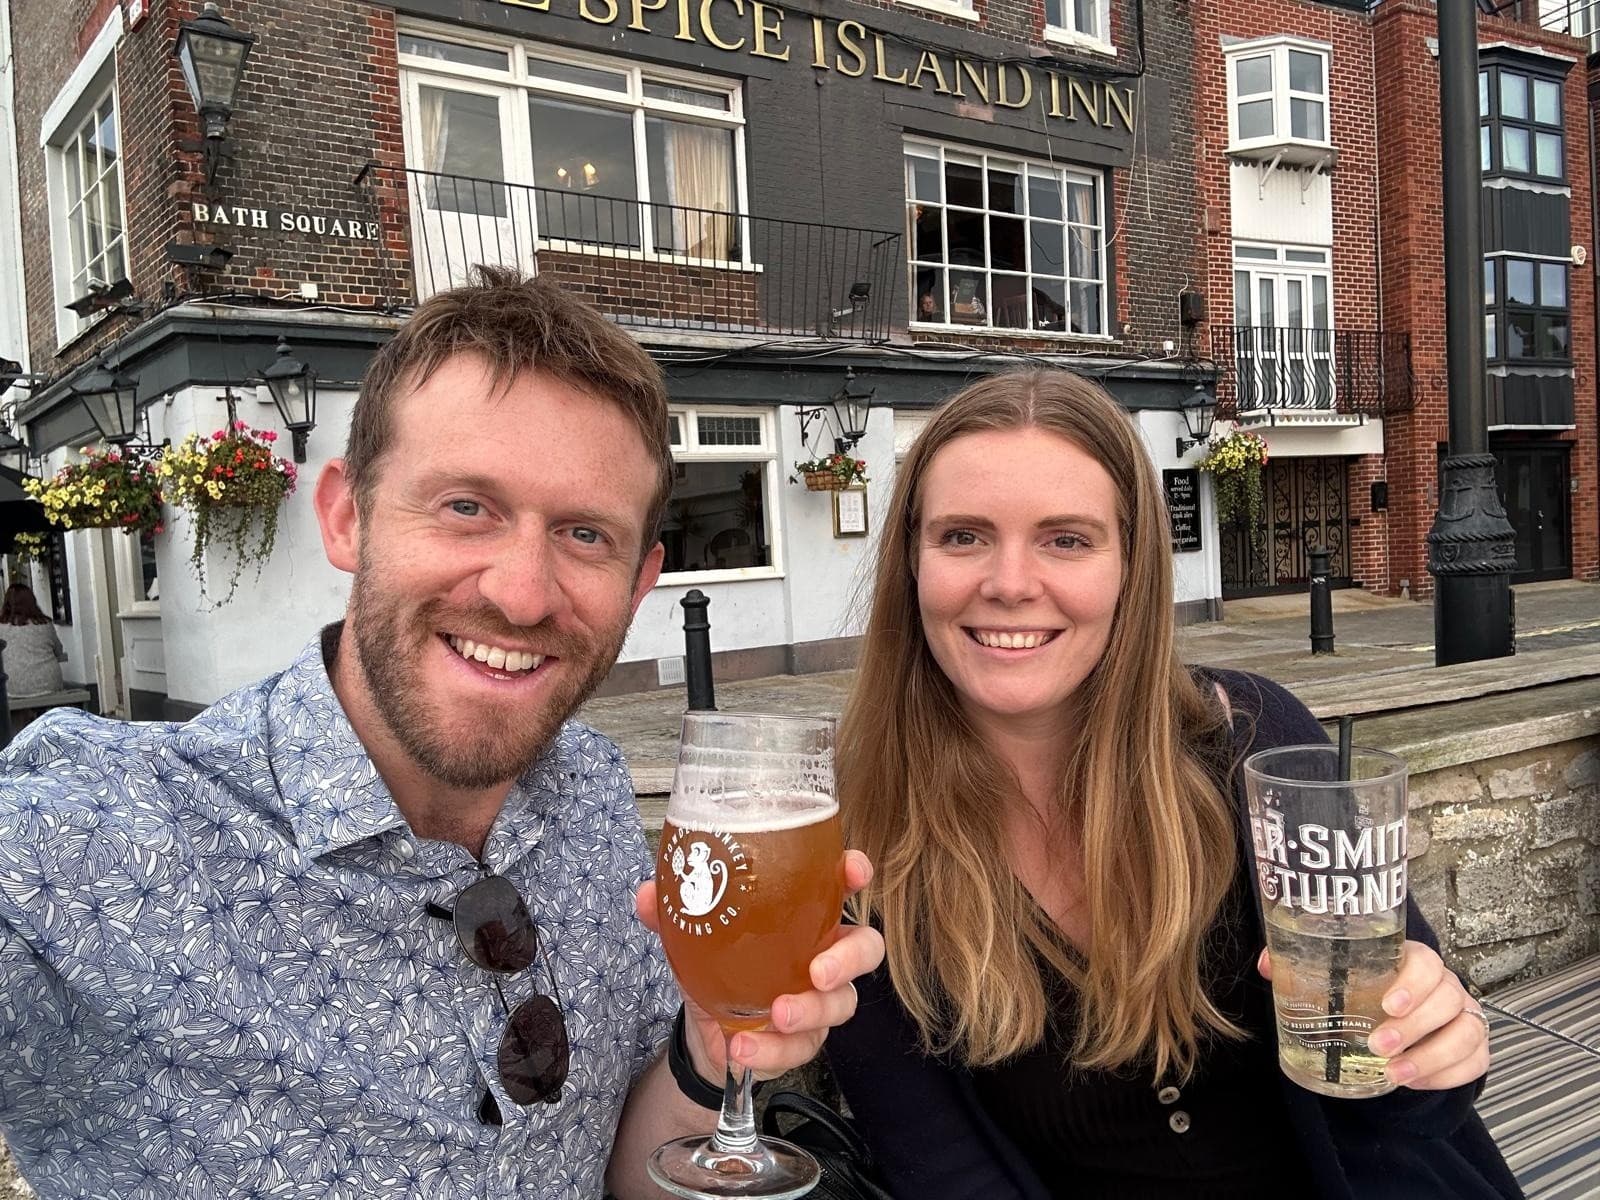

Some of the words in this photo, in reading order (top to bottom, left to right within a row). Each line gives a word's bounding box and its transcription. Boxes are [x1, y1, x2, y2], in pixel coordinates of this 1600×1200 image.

[811, 17, 1032, 109] ISLAND
[1048, 71, 1135, 134] INN
[192, 202, 269, 229] BATH
[280, 211, 379, 241] SQUARE
[1174, 475, 1189, 485] Food
[706, 821, 748, 871] MONKEY
[1274, 859, 1408, 916] TURNE
[662, 894, 713, 936] BREWING
[719, 906, 741, 926] CO.
[1317, 1021, 1334, 1029] THE
[1336, 1020, 1372, 1030] THAMES
